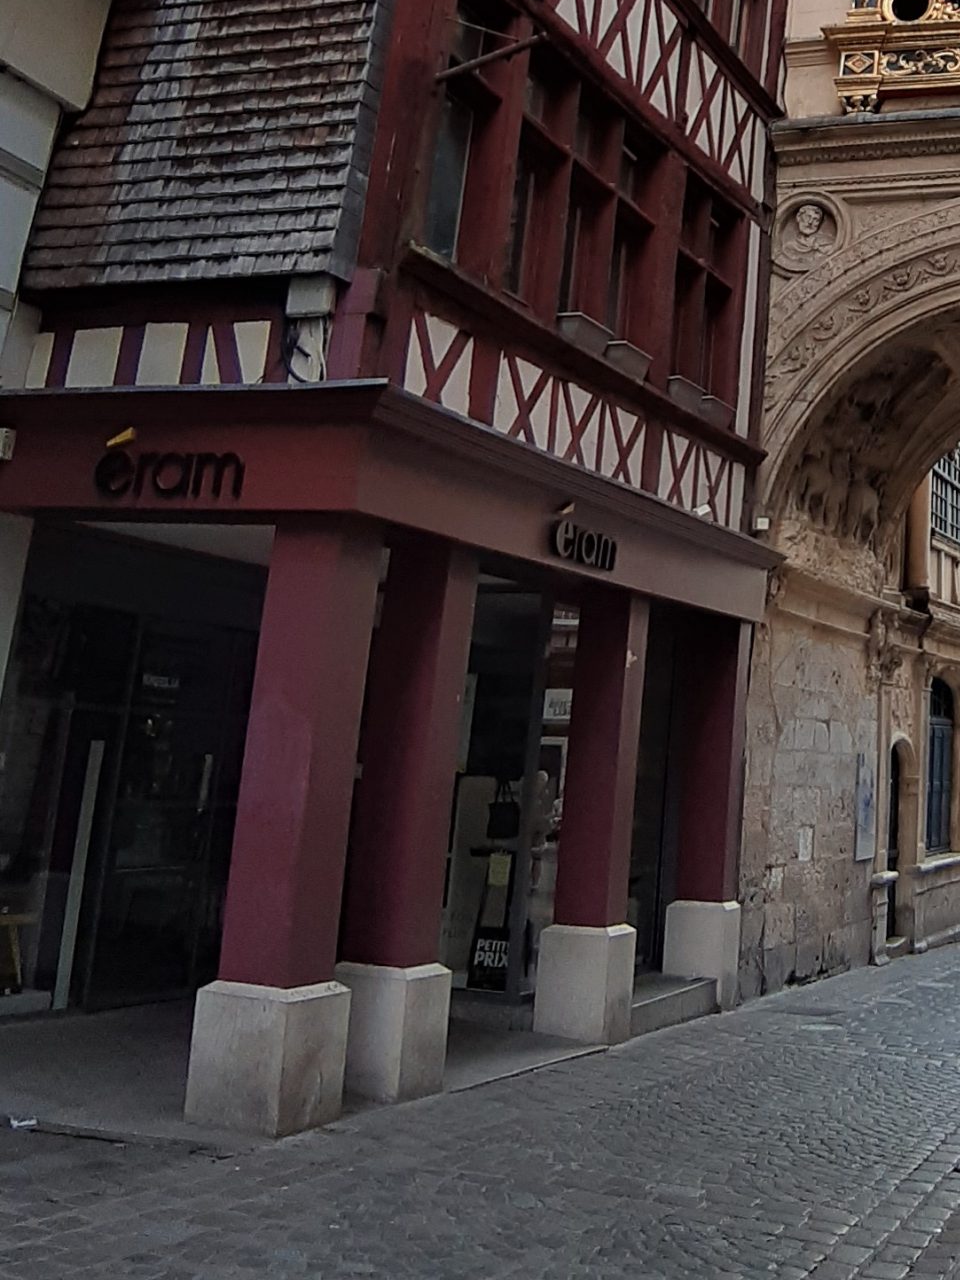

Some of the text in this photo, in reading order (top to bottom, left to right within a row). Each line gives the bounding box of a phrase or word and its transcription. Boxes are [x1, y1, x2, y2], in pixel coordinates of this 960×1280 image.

[95, 426, 246, 500] éram
[550, 502, 617, 571] éram
[474, 950, 508, 967] PRIX
